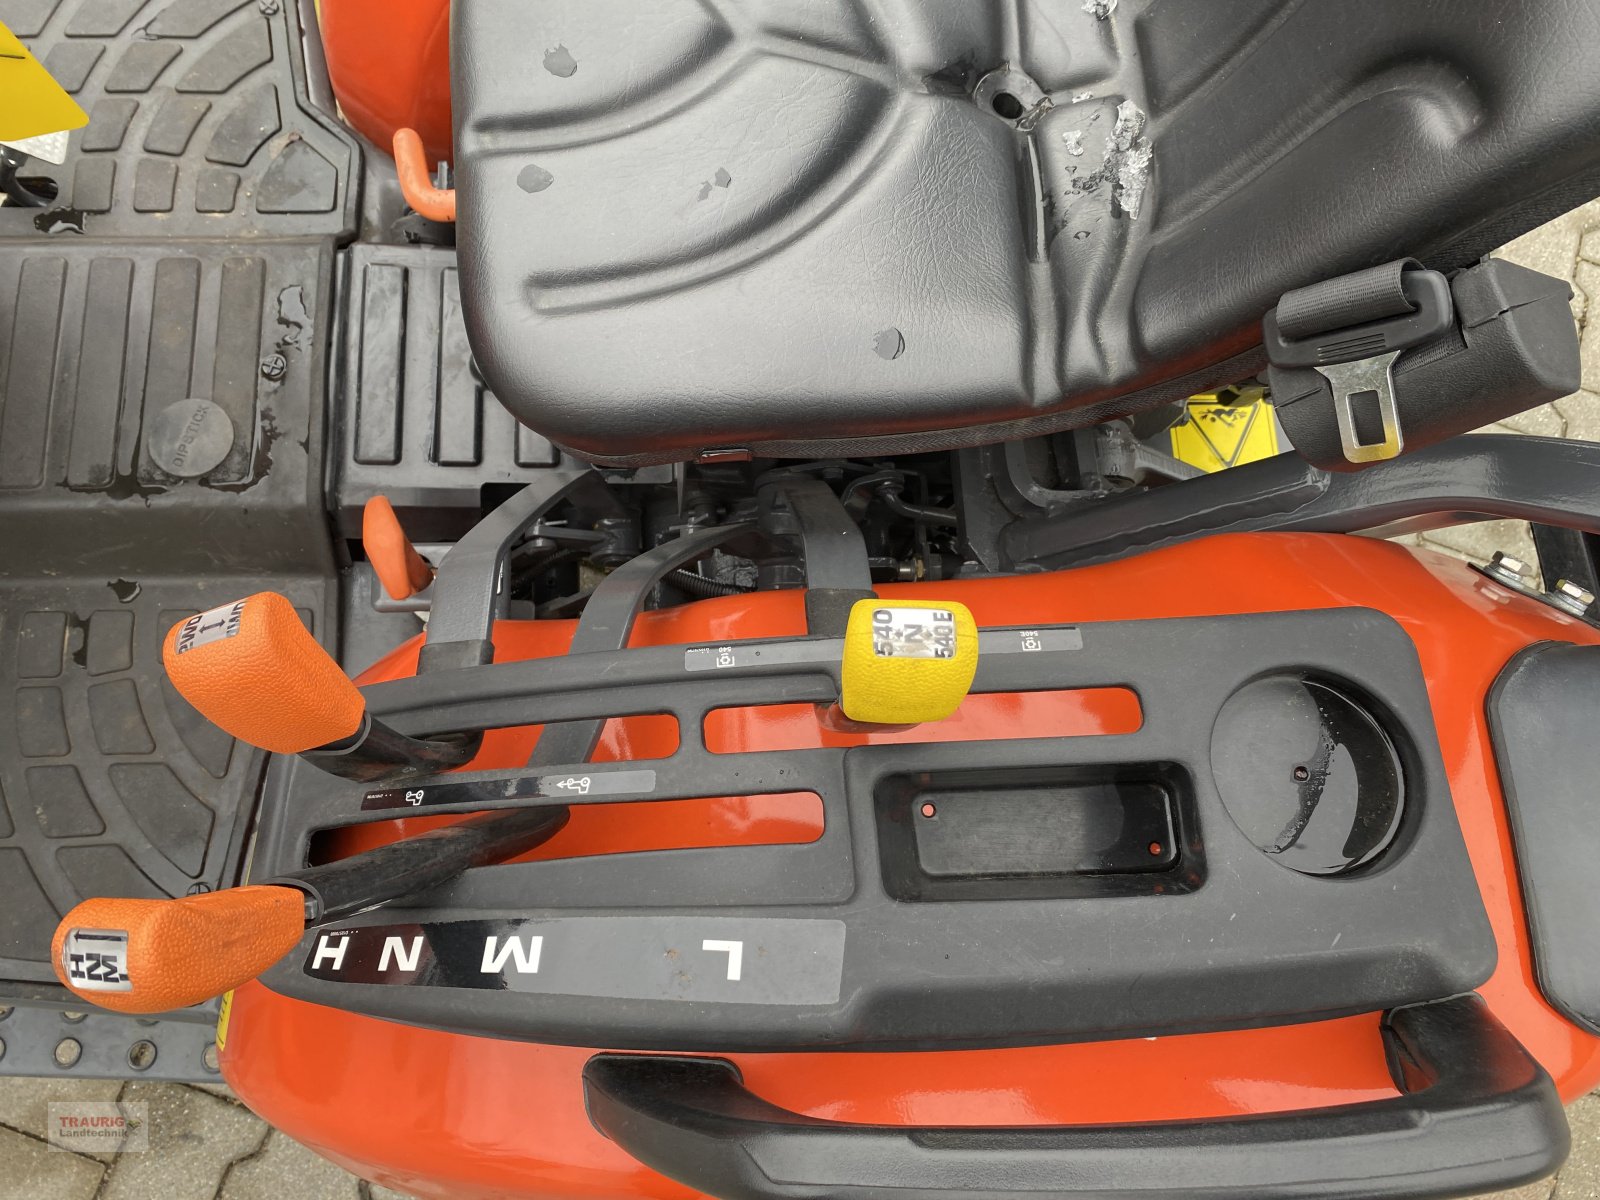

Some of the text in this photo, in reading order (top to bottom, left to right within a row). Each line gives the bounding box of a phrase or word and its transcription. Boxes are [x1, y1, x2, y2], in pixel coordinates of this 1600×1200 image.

[172, 405, 209, 468] DIPSTICK
[873, 609, 893, 656] 540
[904, 624, 922, 643] N
[70, 953, 86, 979] H
[86, 952, 102, 981] N
[311, 935, 743, 980] L M N H
